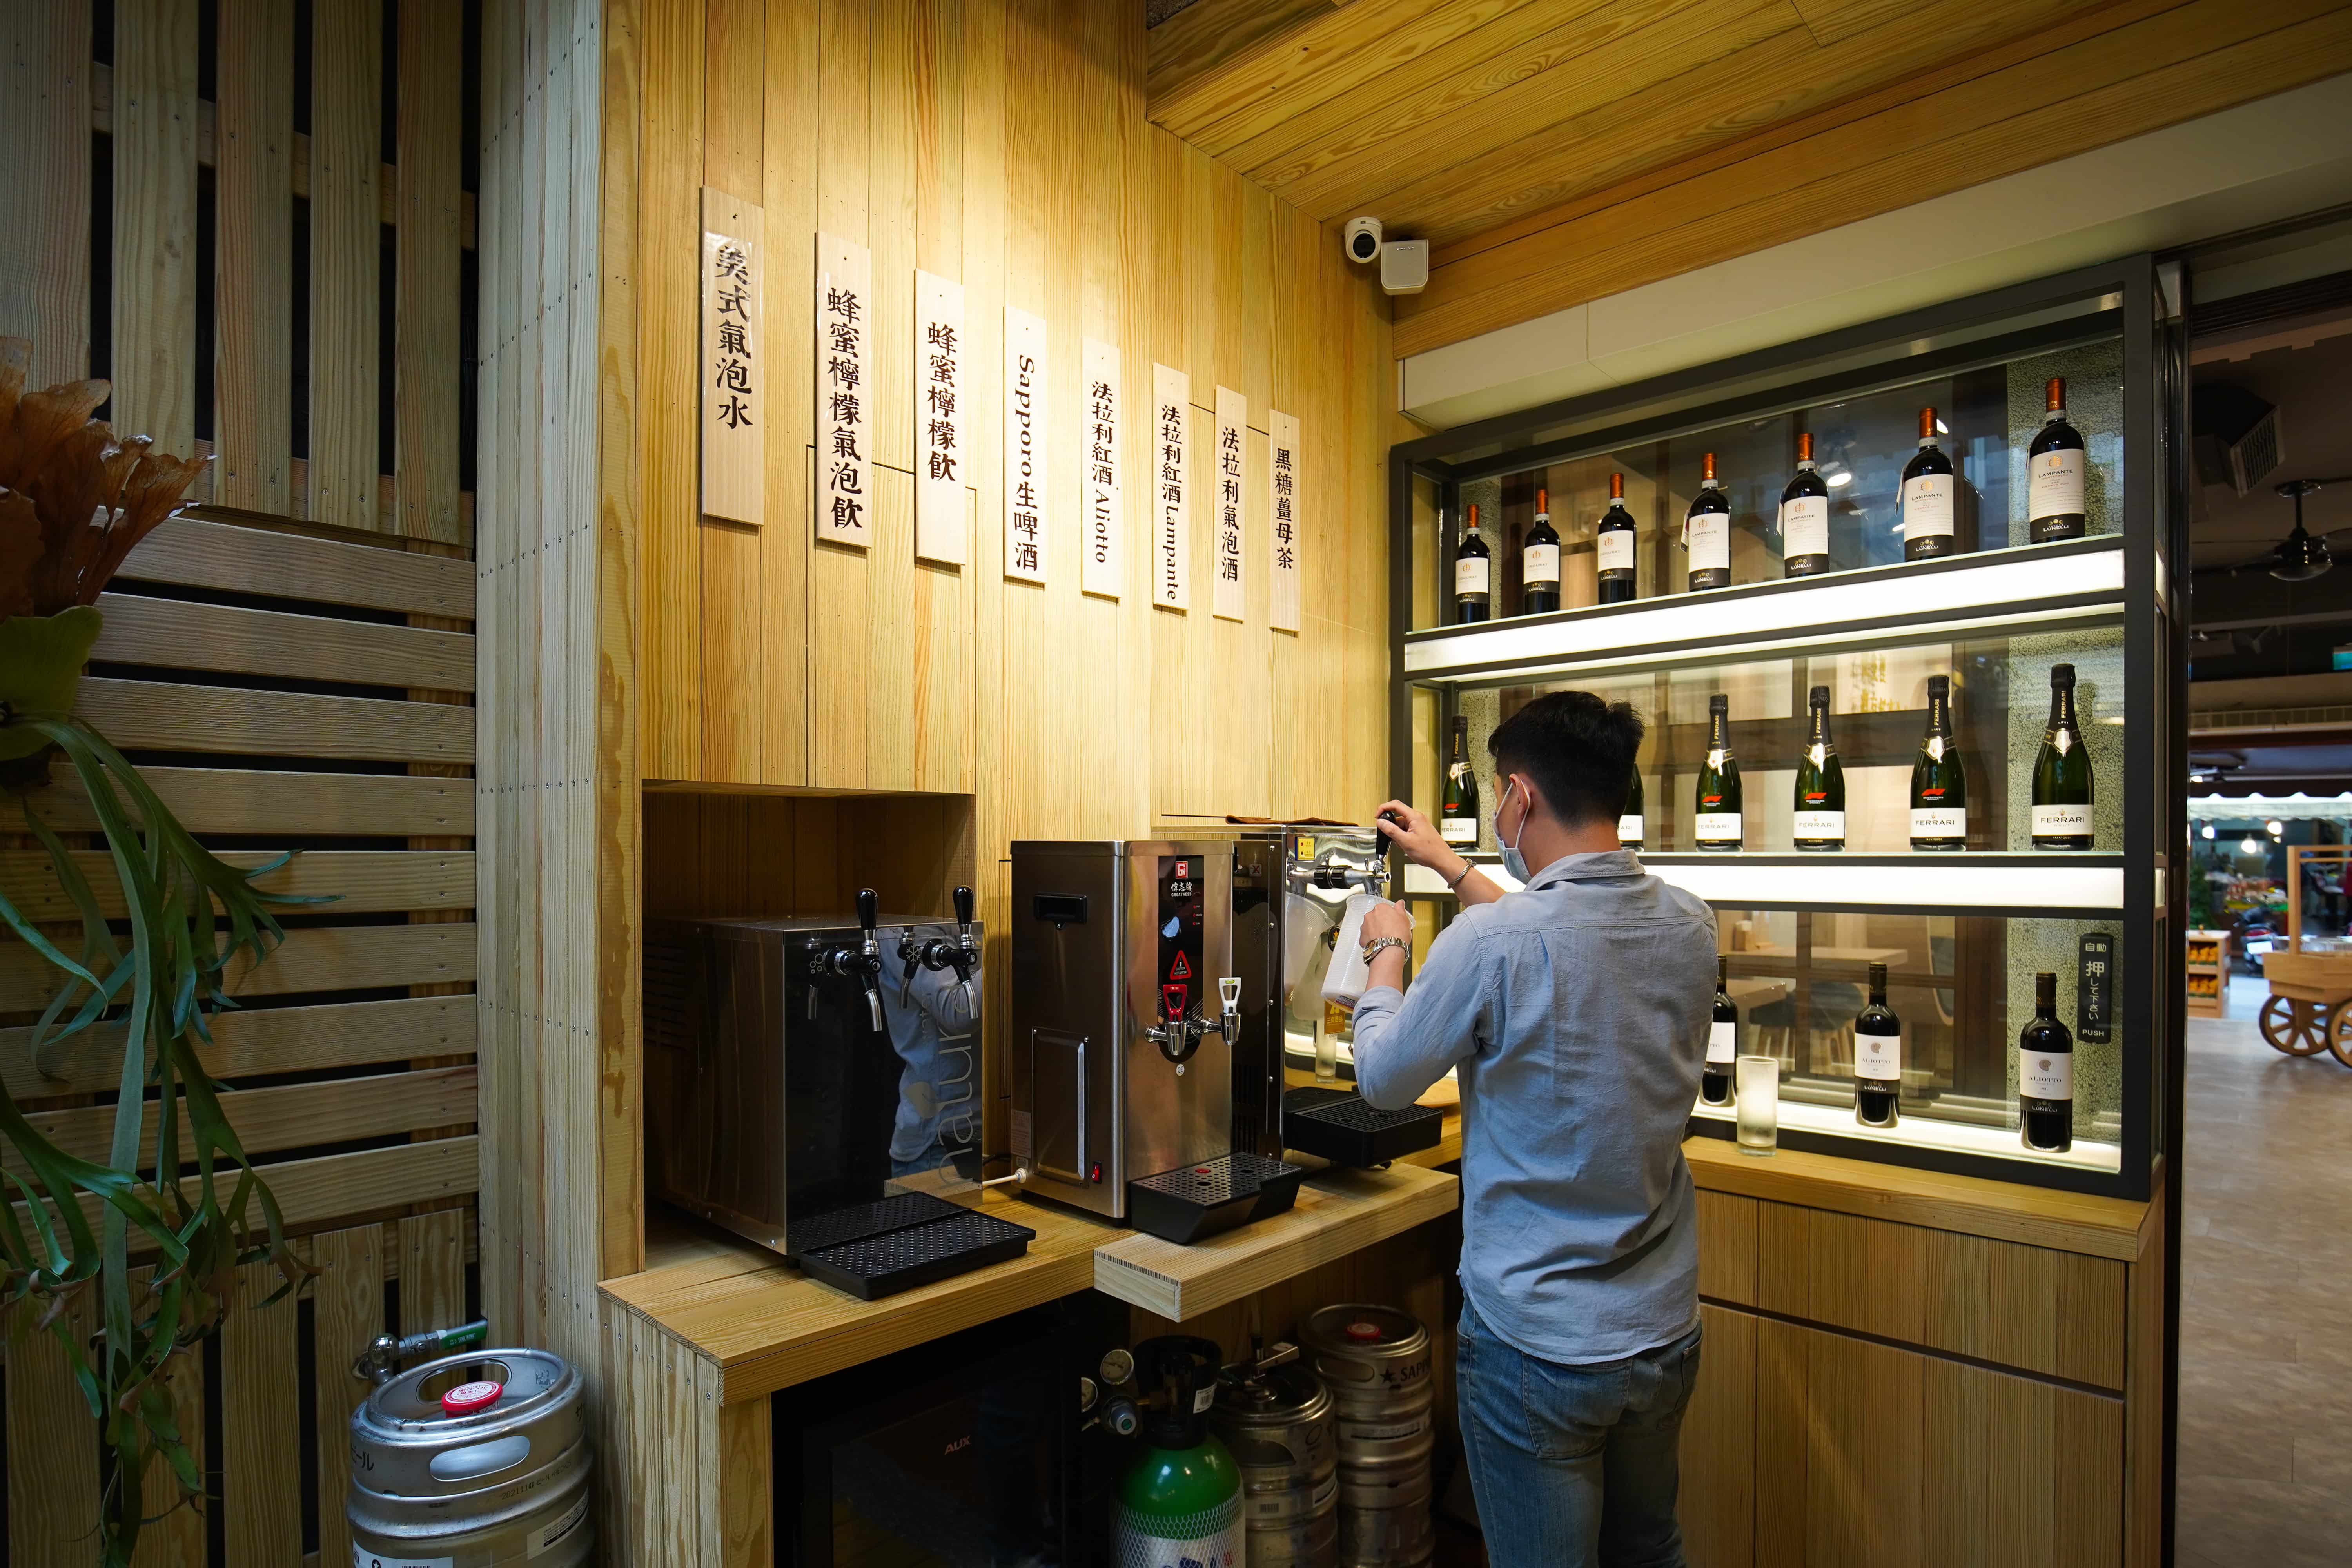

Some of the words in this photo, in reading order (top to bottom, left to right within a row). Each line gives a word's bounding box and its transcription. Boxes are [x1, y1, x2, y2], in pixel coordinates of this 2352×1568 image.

[715, 245, 753, 430] 美式氣泡水
[827, 287, 863, 529] 蜂蜜檸檬氣泡飲
[927, 322, 958, 481] 蜂蜜檸檬飲
[1092, 381, 1114, 486] 法拉利紅酒
[1161, 404, 1183, 503] 法拉利紅酒
[2038, 470, 2073, 478] LAMPANTE
[1096, 489, 1107, 563] Aliotto
[1163, 506, 1178, 600] Lampante
[1221, 426, 1240, 582] 法拉利氣泡酒
[1275, 448, 1294, 569] 黑糖薑母茶
[2085, 942, 2106, 952] 自動
[2086, 960, 2105, 1020] 押して下さい
[944, 1436, 971, 1455] AUX
